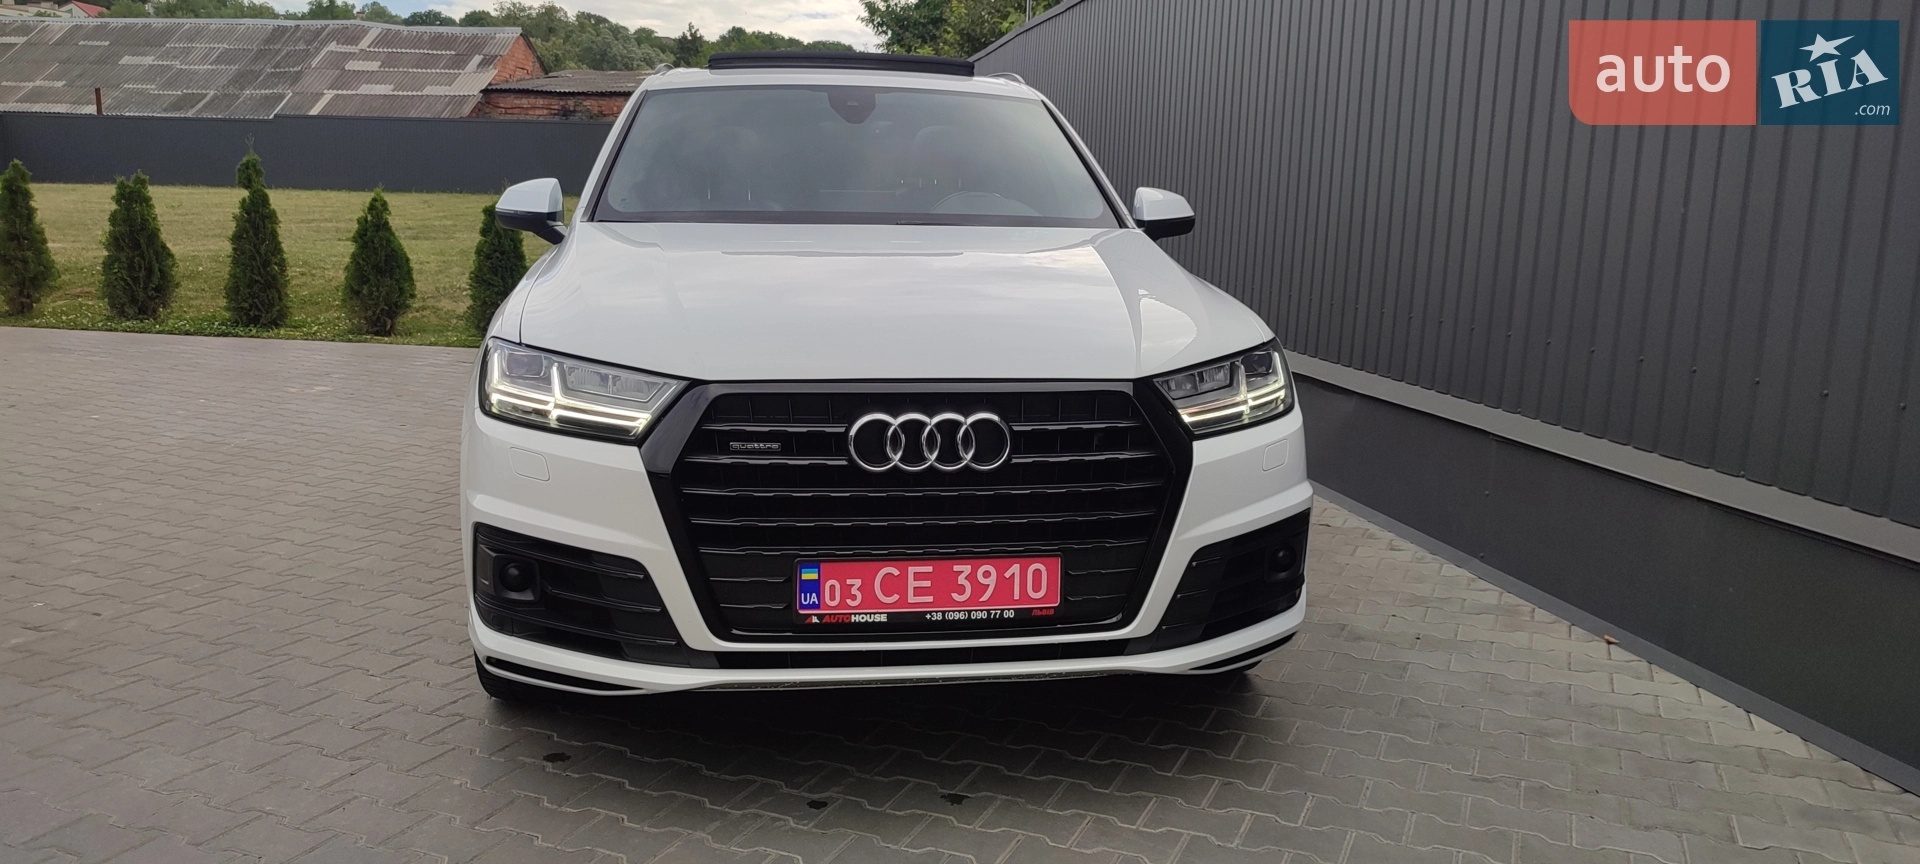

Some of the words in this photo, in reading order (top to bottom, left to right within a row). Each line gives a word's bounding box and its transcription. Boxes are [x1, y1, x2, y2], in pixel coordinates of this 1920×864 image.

[824, 579, 863, 607] 03
[874, 566, 934, 604] CE
[950, 563, 1048, 603] 3910
[801, 592, 819, 605] UA
[925, 612, 943, 621] +38
[945, 610, 969, 620] (096)
[970, 610, 988, 620] 090
[989, 609, 1001, 619] 77
[1003, 609, 1015, 618] 00
